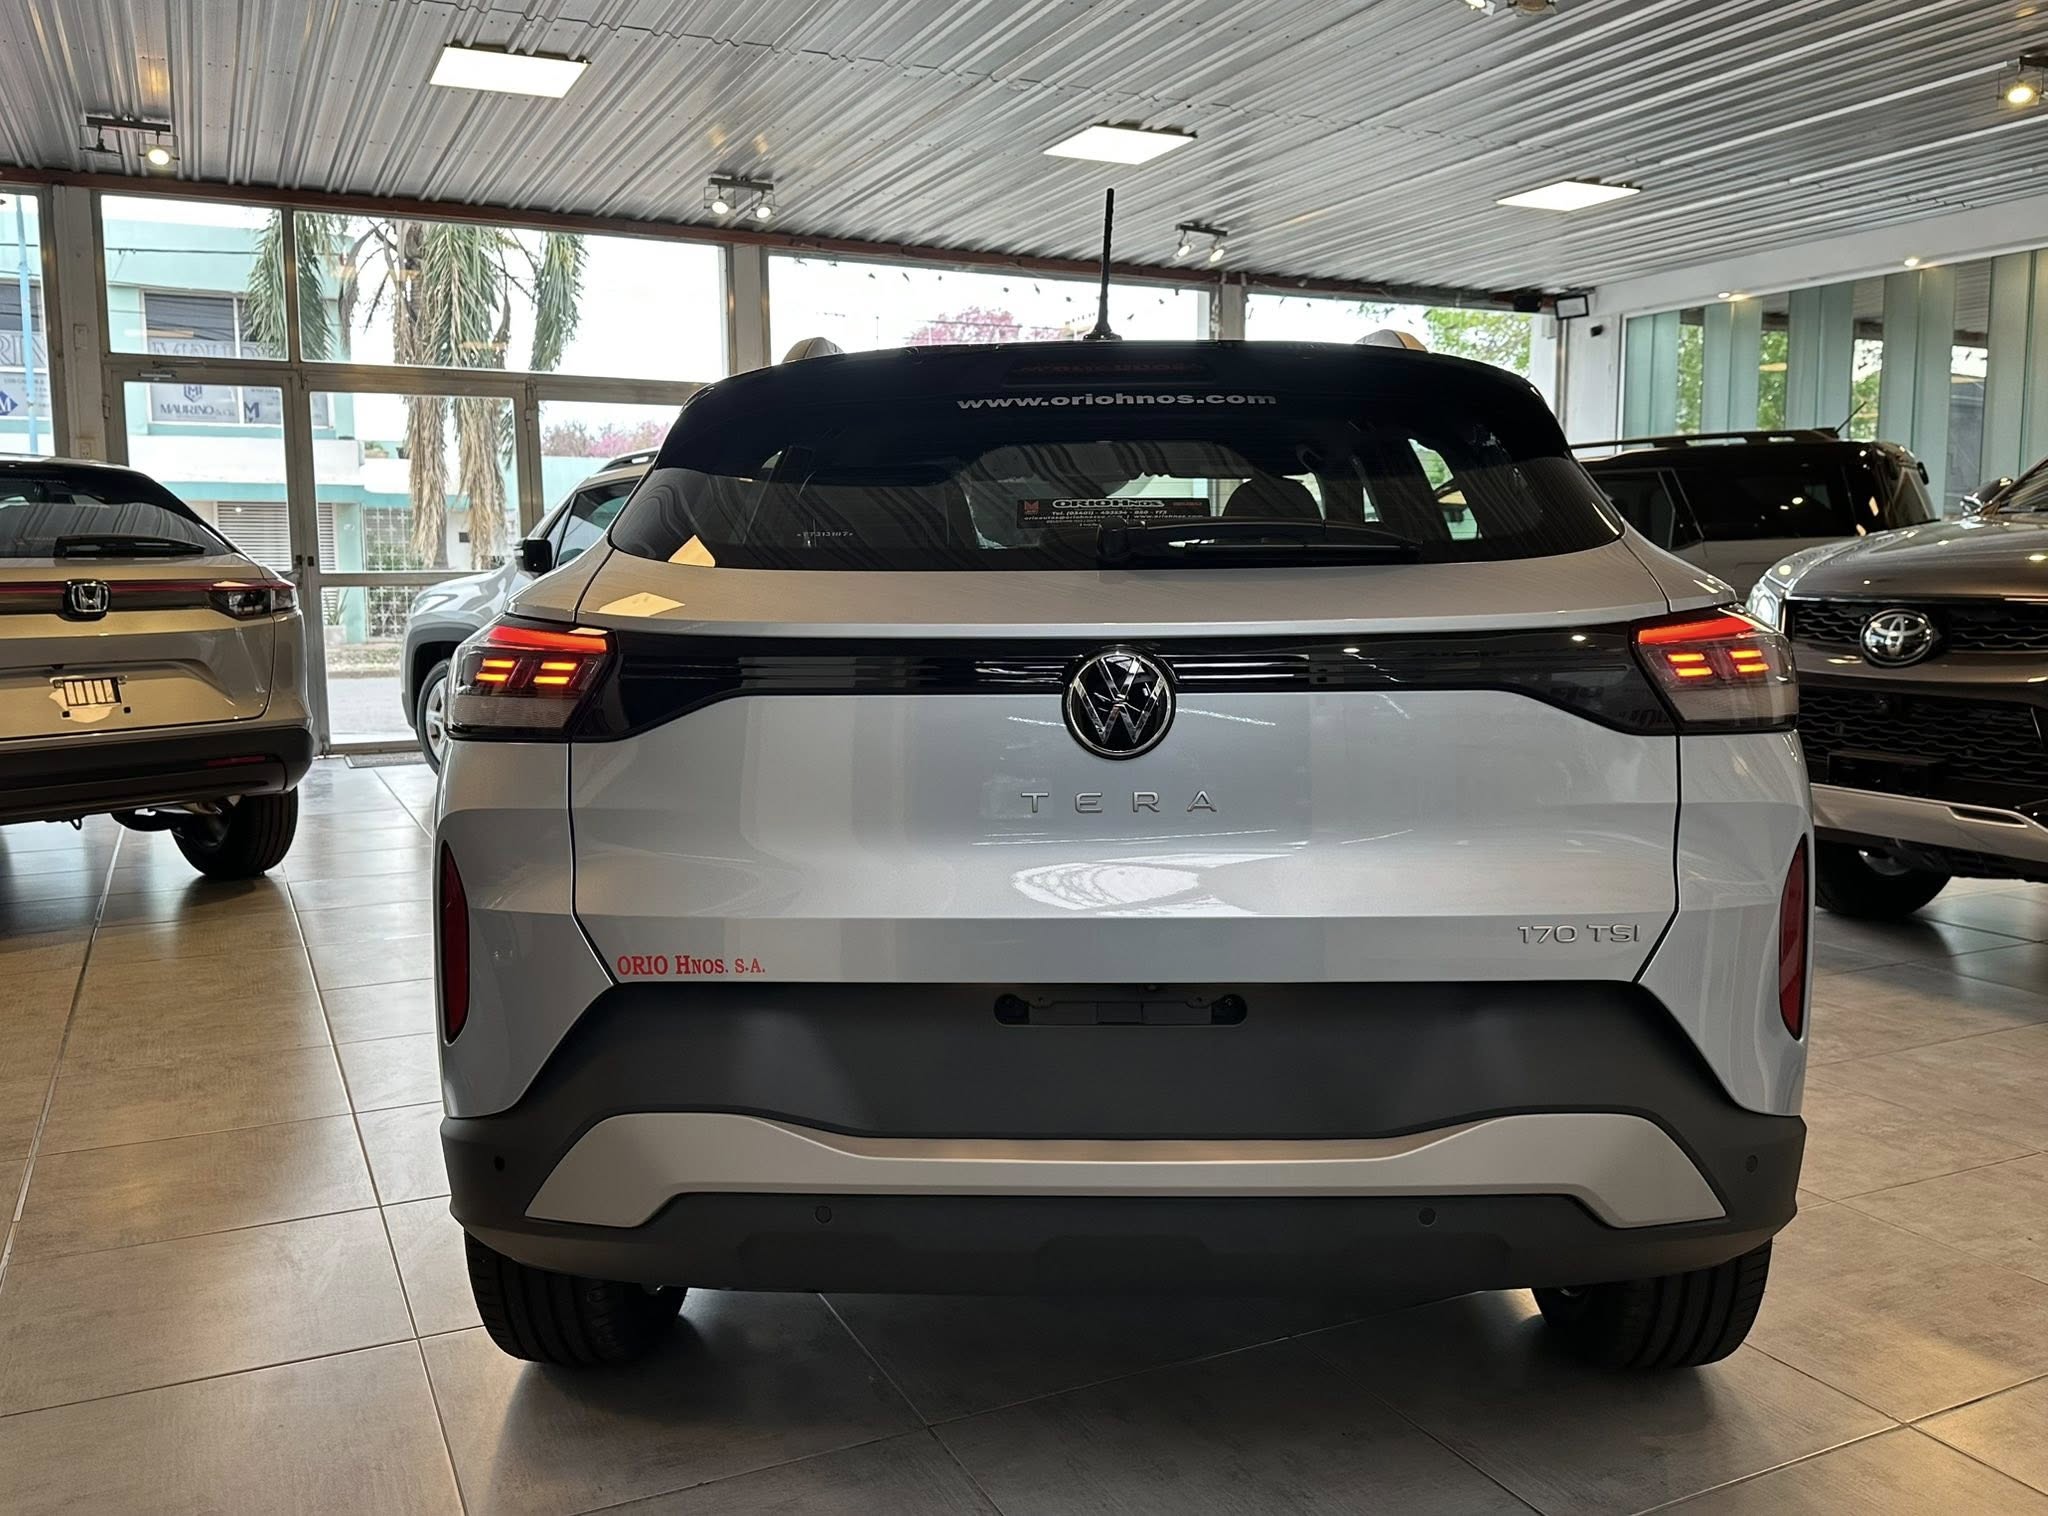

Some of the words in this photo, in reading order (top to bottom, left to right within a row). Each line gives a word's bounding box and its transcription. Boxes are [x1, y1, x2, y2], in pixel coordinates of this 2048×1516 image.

[957, 393, 1278, 409] www.oriohnos.com
[1020, 790, 1218, 814] TERA
[1517, 925, 1578, 944] 170
[1586, 924, 1641, 943] TSI
[617, 955, 669, 976] ORIO
[734, 958, 766, 974] S.A.
